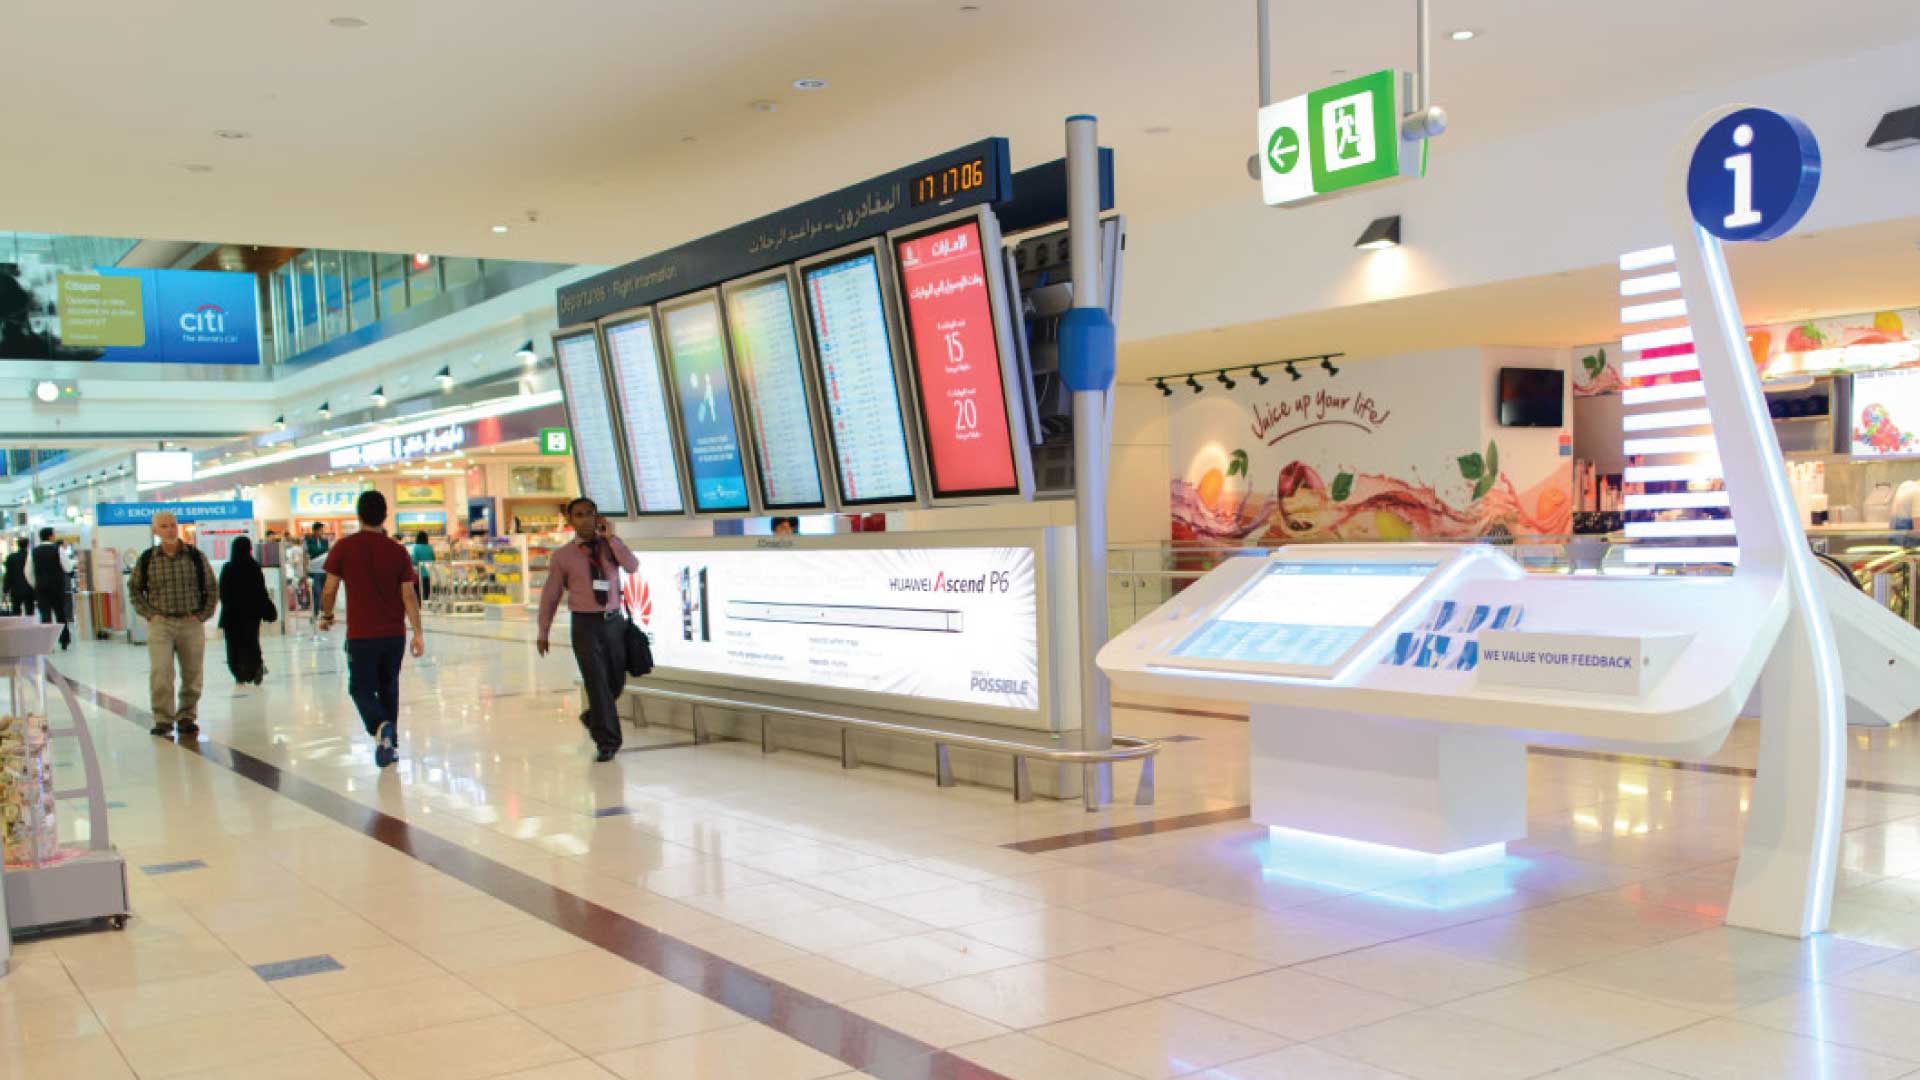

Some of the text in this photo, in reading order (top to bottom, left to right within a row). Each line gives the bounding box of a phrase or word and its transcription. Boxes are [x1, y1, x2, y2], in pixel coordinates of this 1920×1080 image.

[960, 160, 983, 190] 06
[1722, 124, 1763, 228] i
[179, 309, 225, 333] citi
[945, 331, 964, 363] 15
[954, 399, 977, 430] 20
[1252, 402, 1291, 440] Juice
[1295, 395, 1311, 420] up
[1316, 388, 1351, 420] your
[185, 506, 226, 516] SERVICE
[888, 570, 1010, 593] HUAWEI Ascend P6
[1484, 650, 1632, 668] WE VALUE YOUR FEEDBACK
[970, 677, 1029, 695] POSSIBLE
